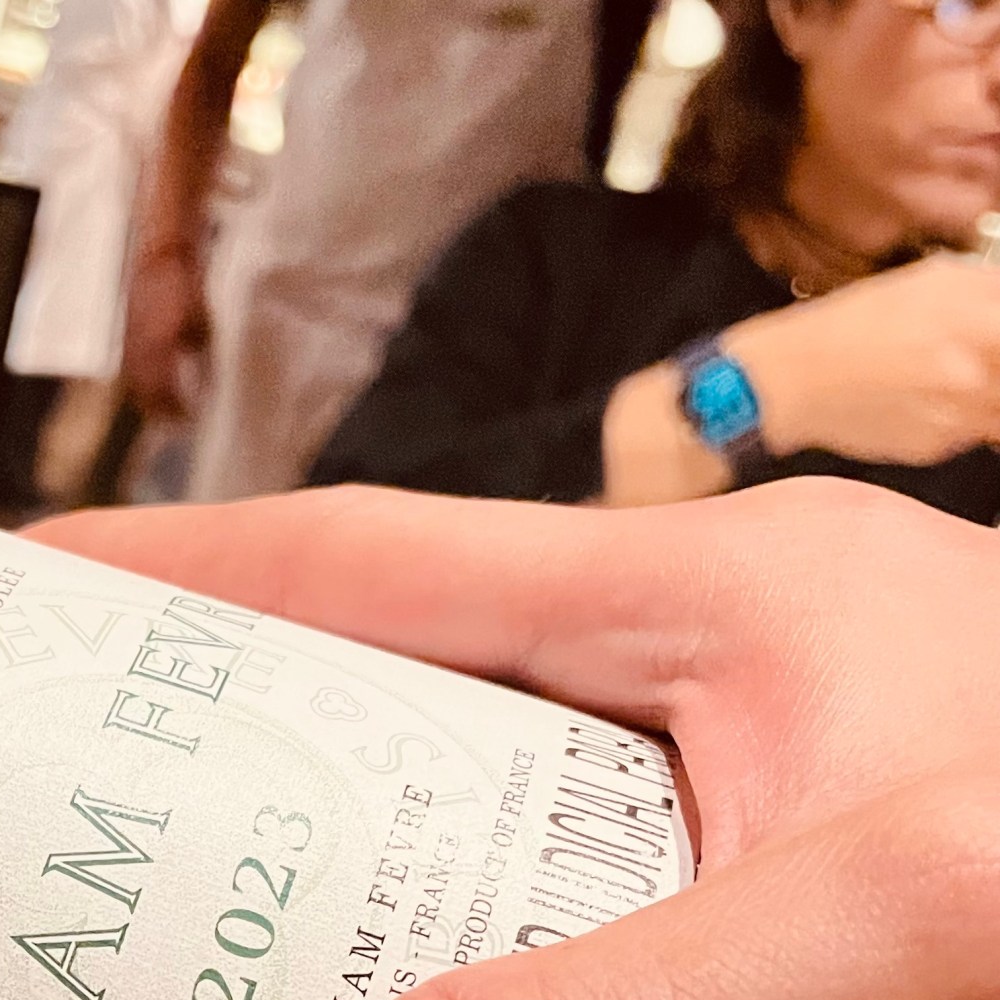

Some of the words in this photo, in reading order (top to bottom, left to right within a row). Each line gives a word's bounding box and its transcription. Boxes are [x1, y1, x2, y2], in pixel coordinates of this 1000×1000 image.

[102, 596, 264, 756] FEVR
[491, 818, 516, 848] OF
[500, 748, 535, 817] FRANCE
[366, 784, 433, 912] FEVRE
[409, 833, 460, 940] FRANCE
[453, 851, 507, 965] PRODUCT
